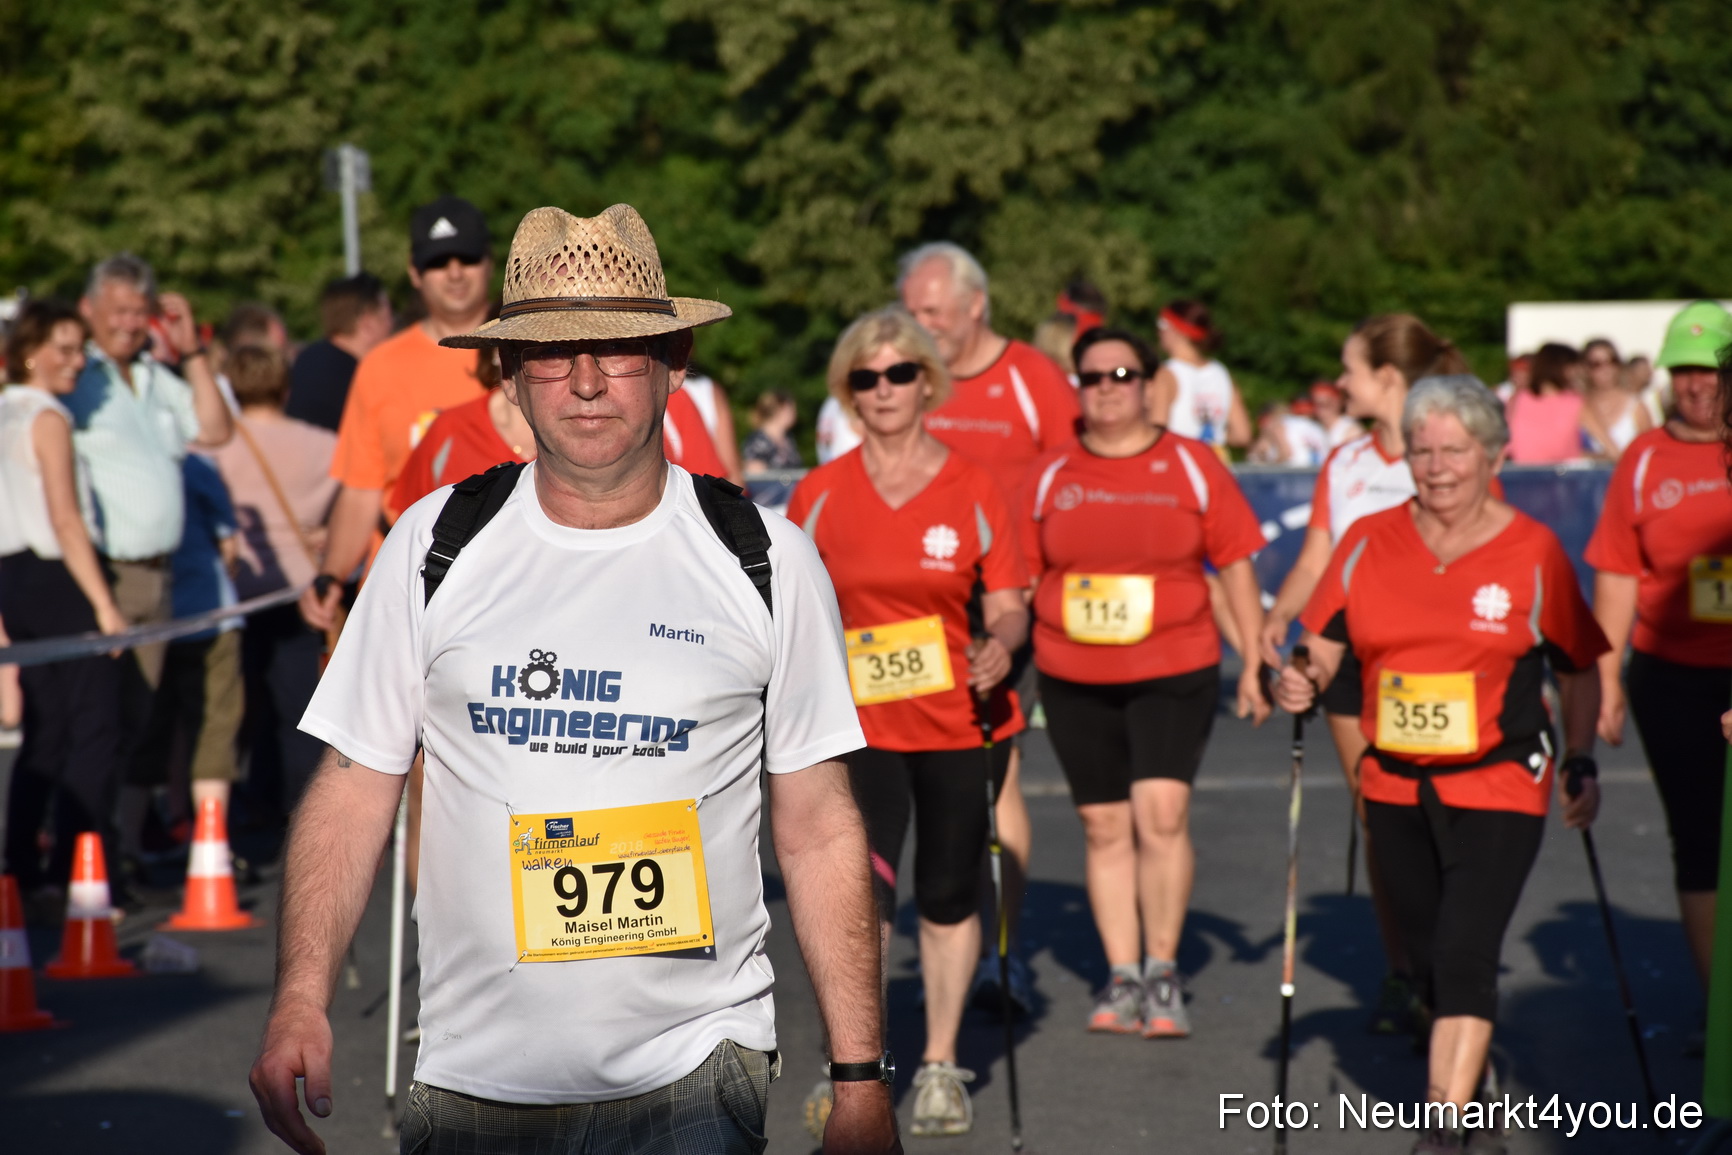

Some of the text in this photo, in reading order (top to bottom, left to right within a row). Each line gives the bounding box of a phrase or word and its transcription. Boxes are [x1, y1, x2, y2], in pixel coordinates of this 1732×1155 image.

[1083, 599, 1128, 622] 114
[649, 623, 705, 645] Martin
[868, 648, 924, 680] 358
[1394, 700, 1449, 730] 355
[467, 702, 699, 752] Engineering
[529, 741, 548, 753] we
[554, 741, 587, 755] build
[592, 744, 628, 758] your
[534, 832, 600, 850] firmenlauf
[609, 839, 644, 855] 2018
[552, 858, 665, 918] 979
[564, 914, 664, 934] Maisel Martin
[551, 927, 677, 948] König Engineering GmbH
